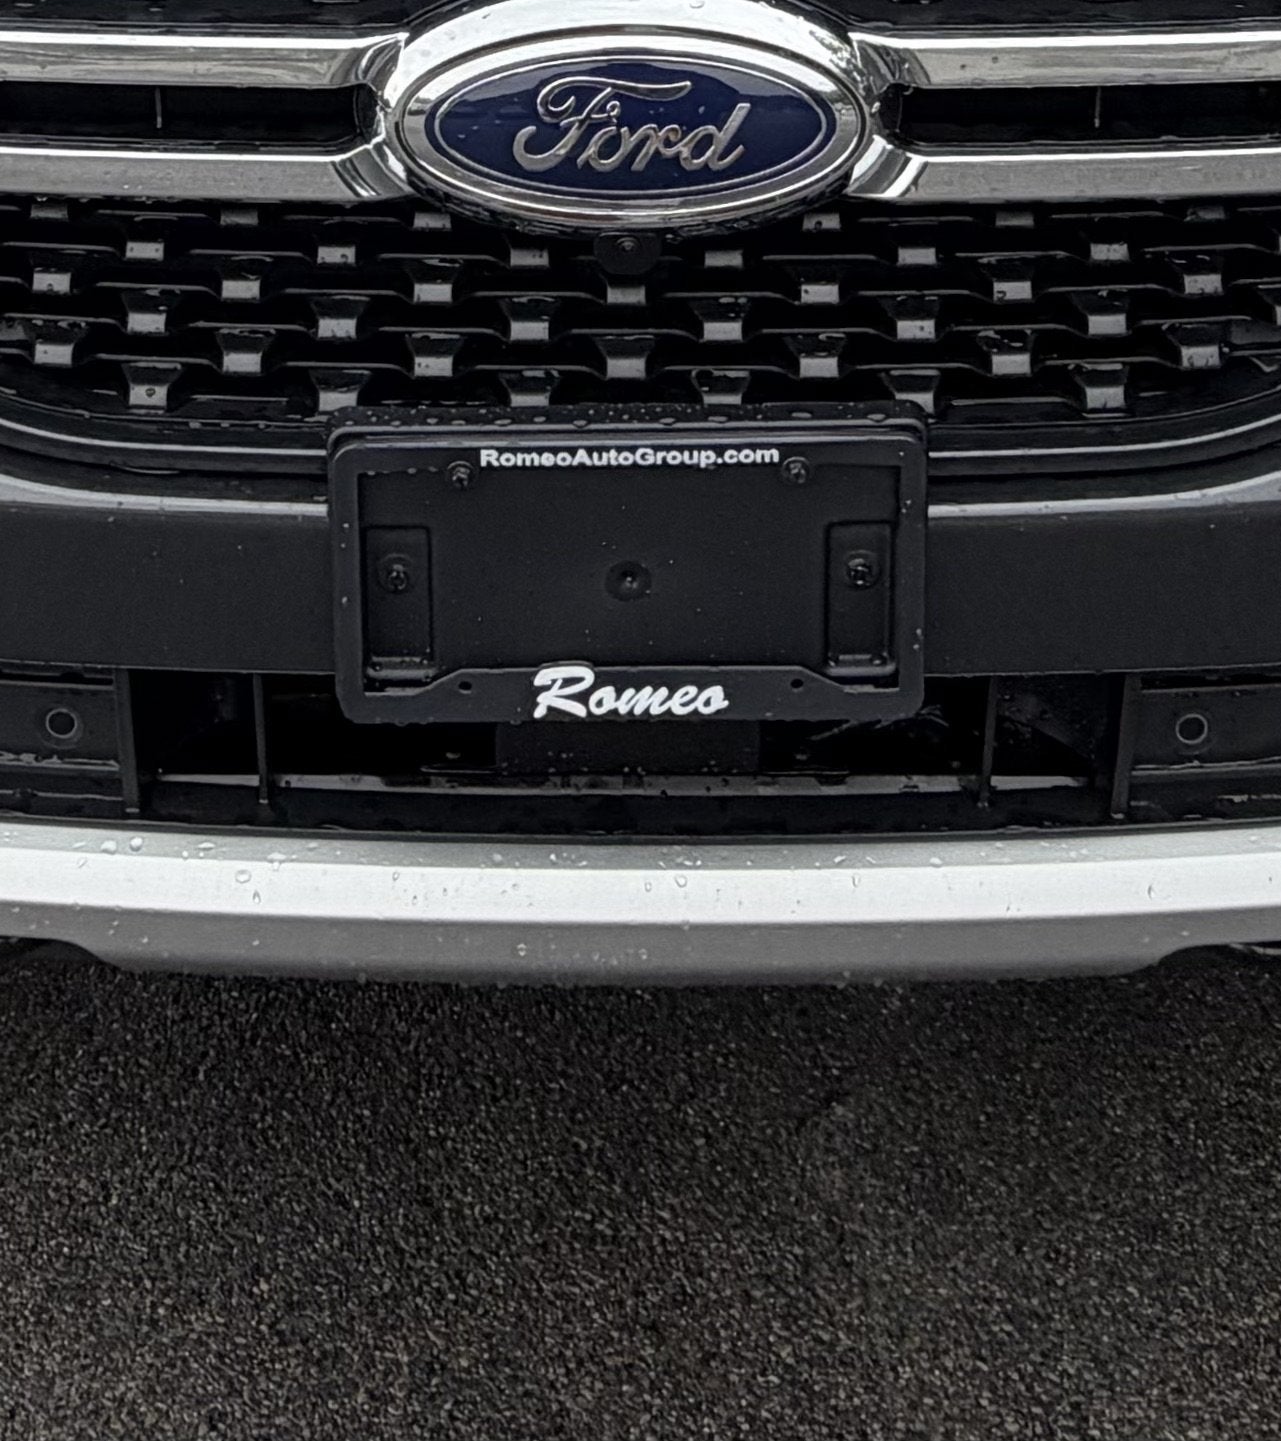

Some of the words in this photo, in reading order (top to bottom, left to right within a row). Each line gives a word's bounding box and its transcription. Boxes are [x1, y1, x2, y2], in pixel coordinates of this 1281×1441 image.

[513, 76, 751, 173] Ford
[480, 448, 780, 468] RomeoAutoGroup.com
[532, 666, 729, 720] Romeo
